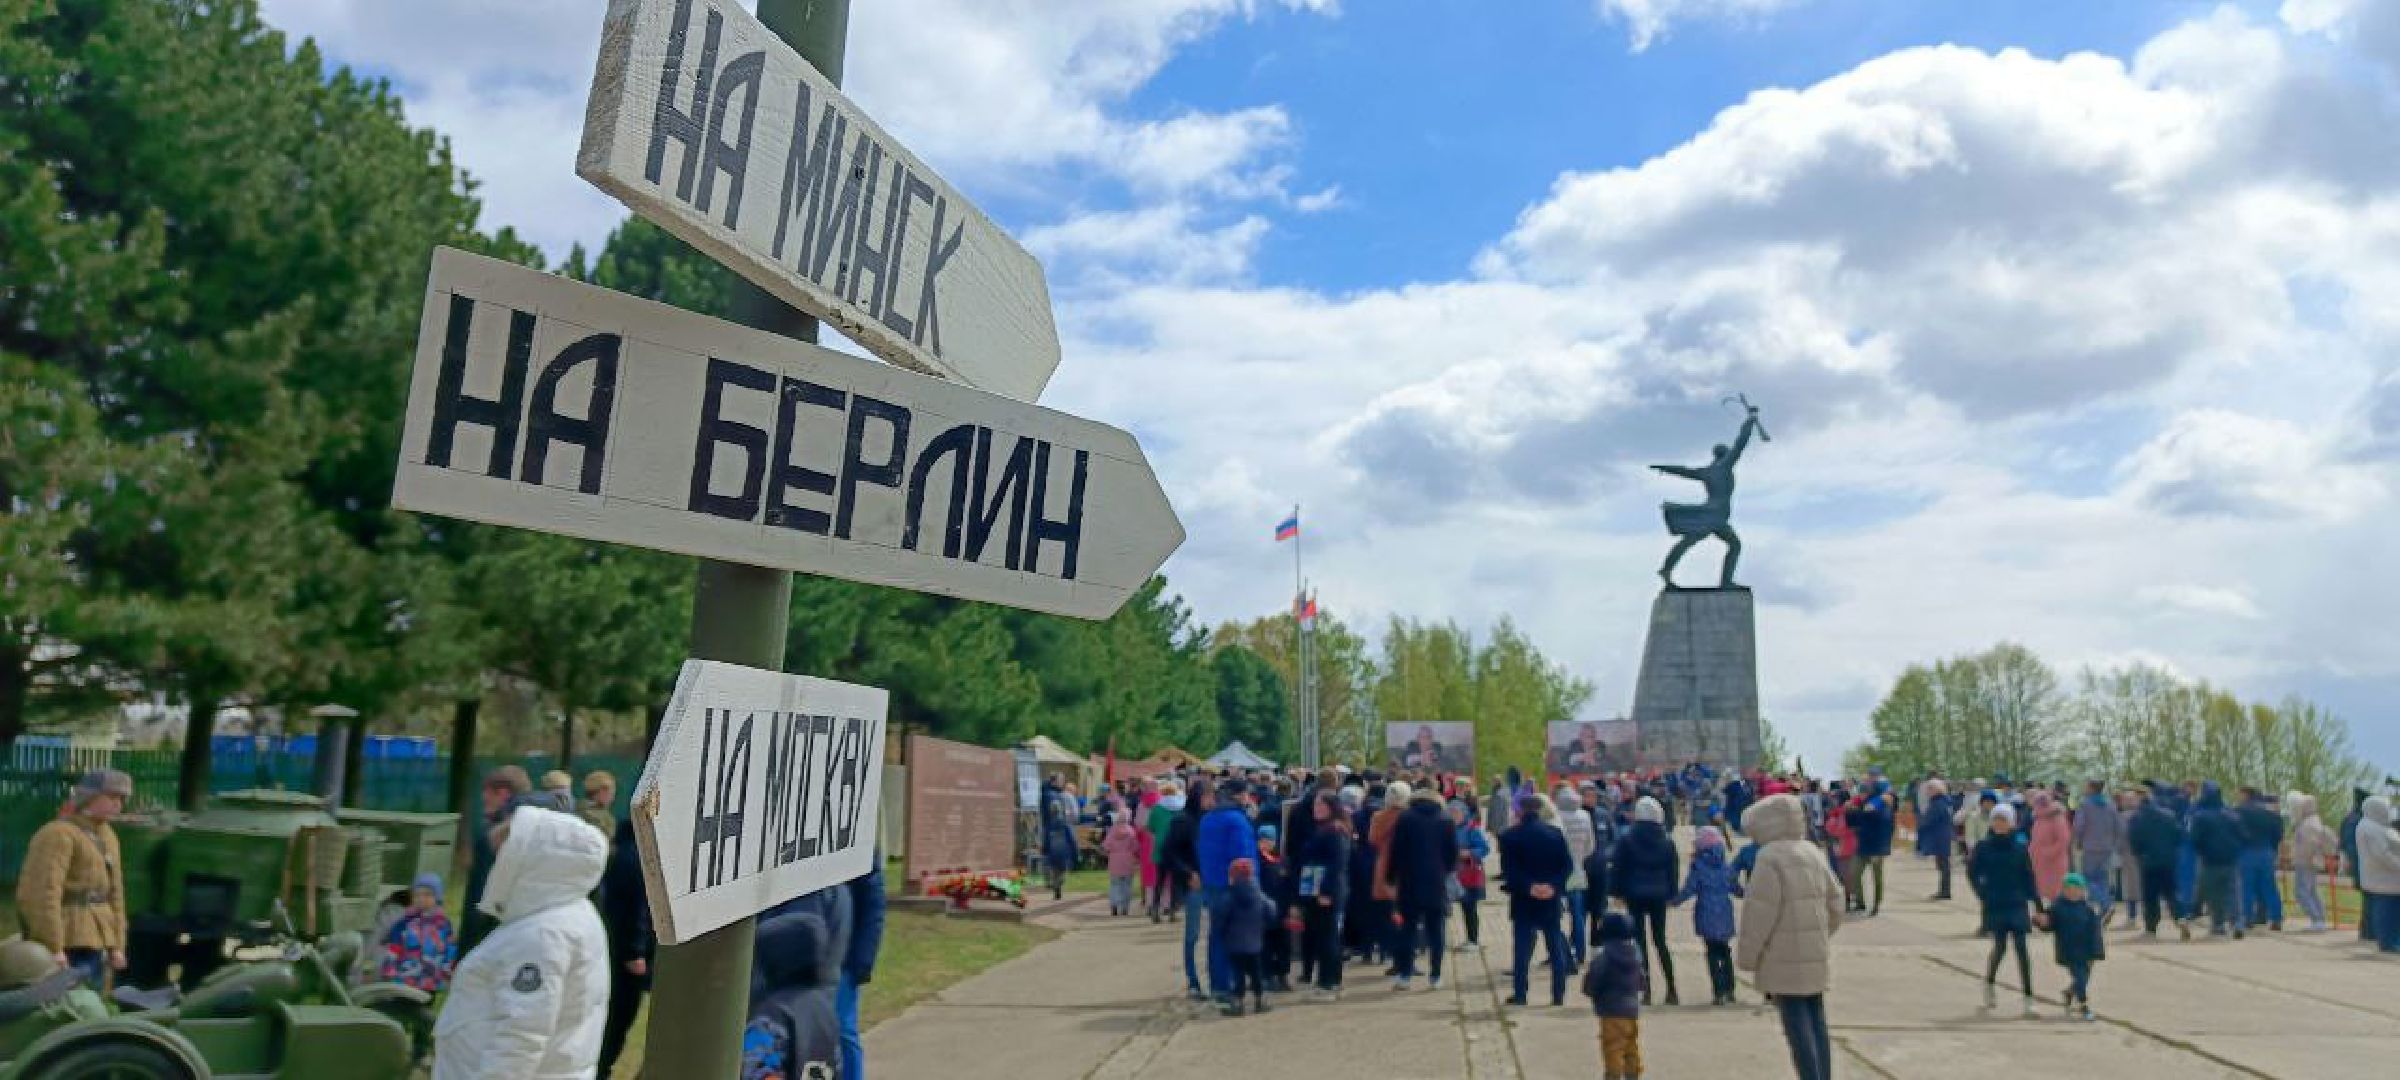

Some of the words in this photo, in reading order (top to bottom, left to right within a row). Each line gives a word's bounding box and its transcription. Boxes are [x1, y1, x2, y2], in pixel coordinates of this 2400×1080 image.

[645, 0, 766, 231] НА
[772, 79, 965, 358] МИНСК
[425, 293, 622, 495] НА
[688, 356, 1088, 580] БЕРЛИН
[689, 707, 754, 893] НА
[757, 711, 878, 873] МОСКВУ
